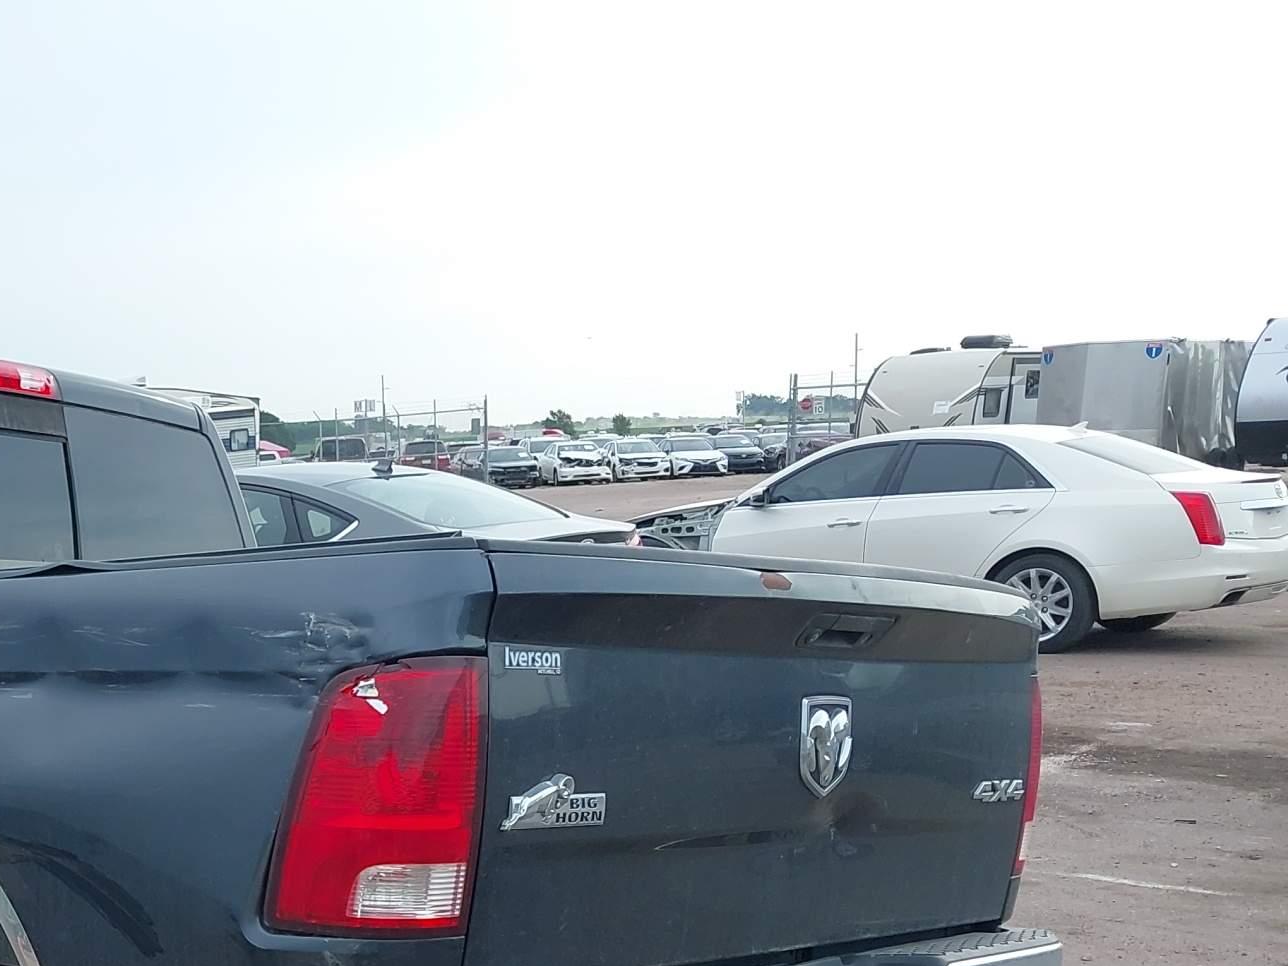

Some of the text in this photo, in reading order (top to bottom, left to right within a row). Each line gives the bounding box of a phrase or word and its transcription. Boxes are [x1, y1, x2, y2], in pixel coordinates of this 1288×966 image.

[505, 646, 561, 667] Iverson
[569, 798, 598, 809] BIG
[555, 811, 603, 823] HORN
